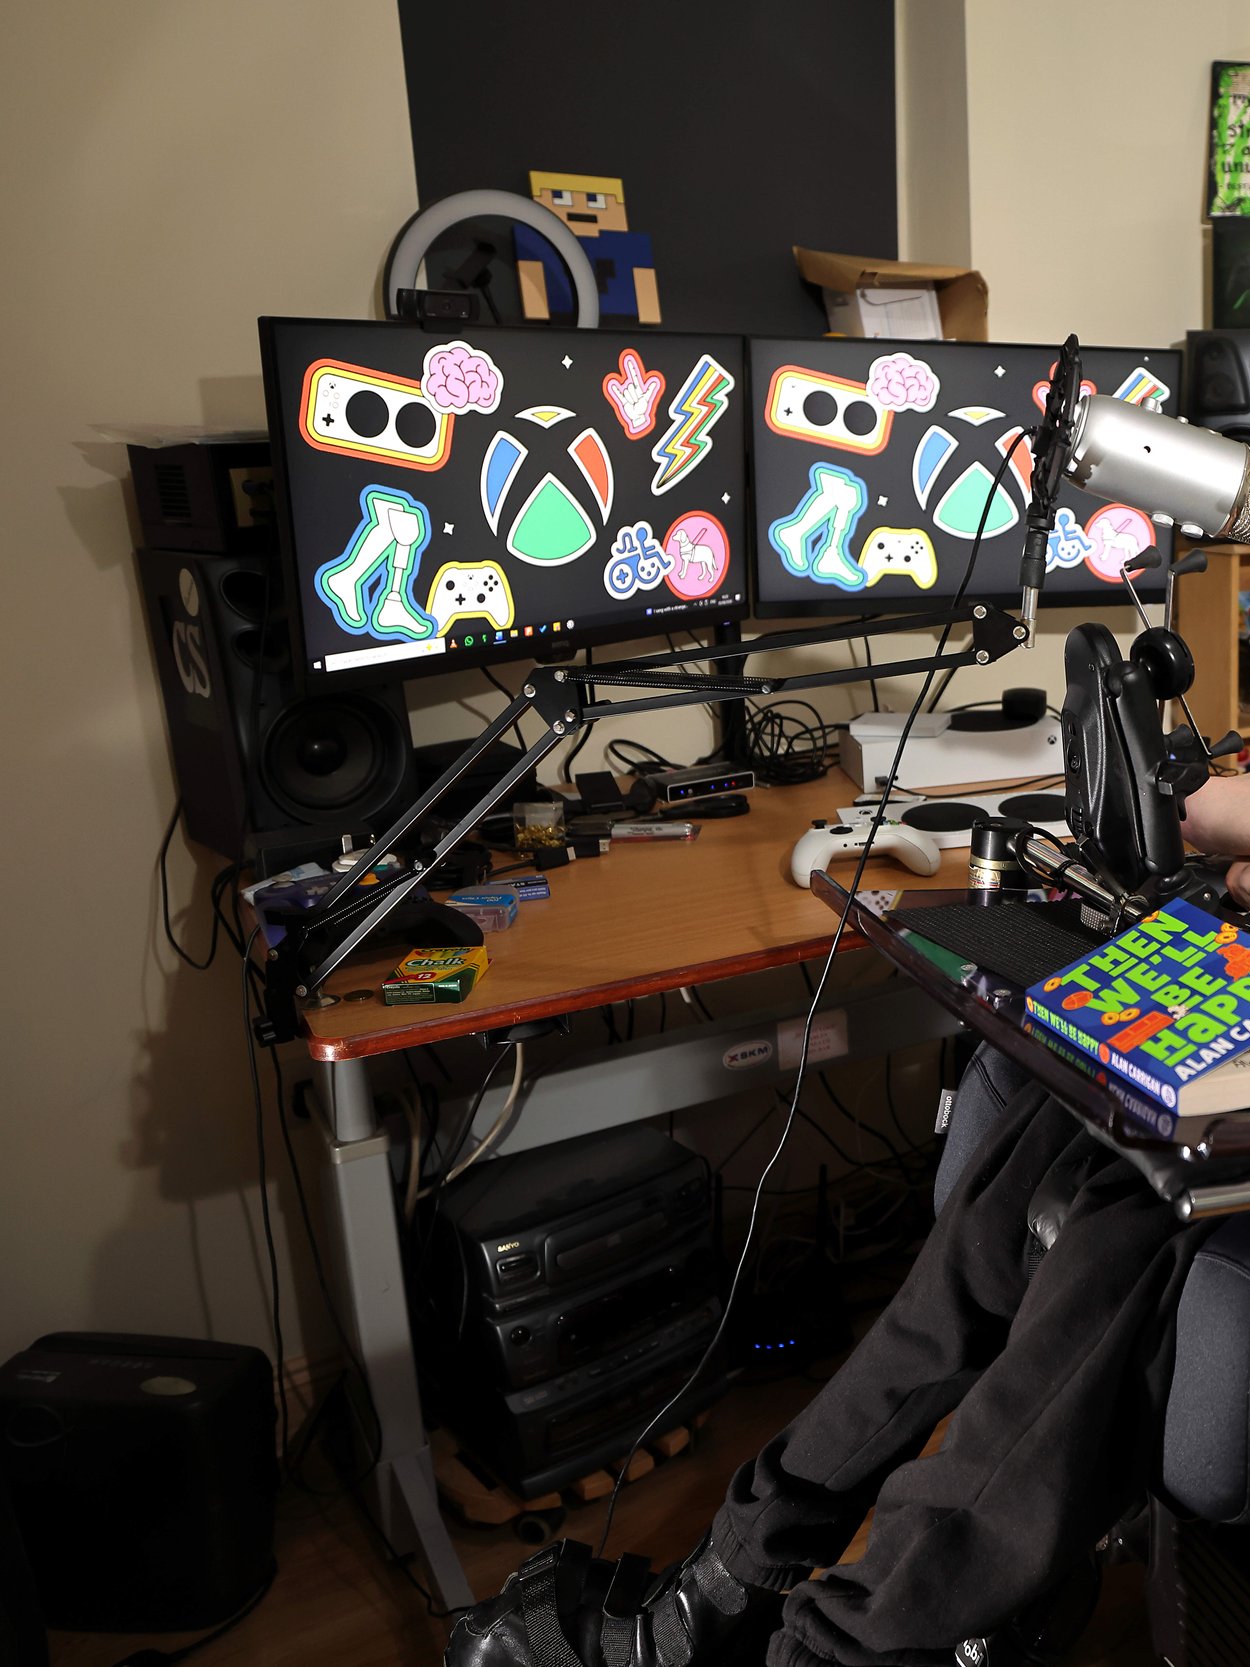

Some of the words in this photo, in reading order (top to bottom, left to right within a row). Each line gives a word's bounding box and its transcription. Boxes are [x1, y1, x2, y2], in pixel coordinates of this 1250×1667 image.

[405, 957, 465, 967] Chalk
[1060, 910, 1189, 992] THEN
[1150, 966, 1228, 1008] BE
[1033, 1000, 1050, 1023] THEN
[1111, 1052, 1128, 1073] ALAN
[1128, 1062, 1161, 1096] CARRIGAN
[1173, 1037, 1236, 1081] ALAN
[940, 1095, 952, 1128] ottobock
[497, 1241, 520, 1253] SANYO
